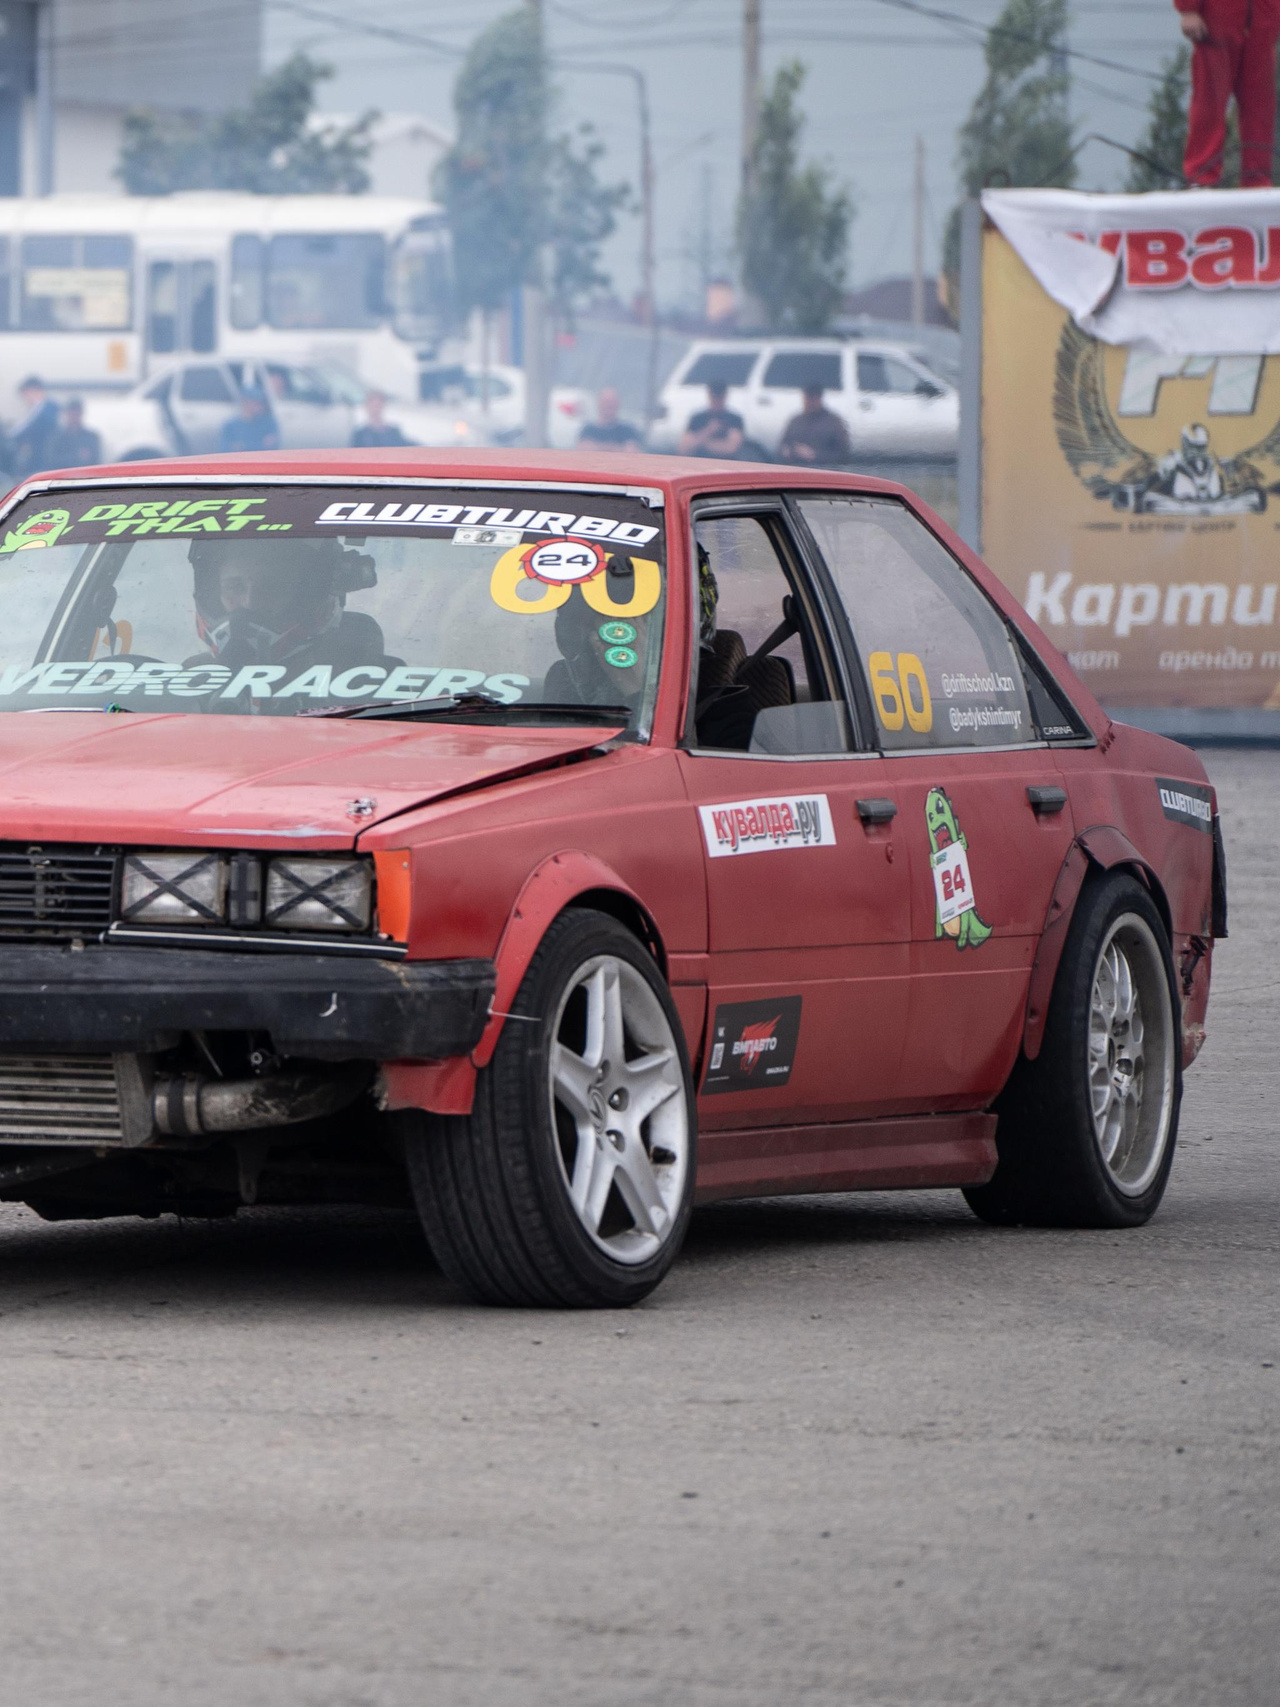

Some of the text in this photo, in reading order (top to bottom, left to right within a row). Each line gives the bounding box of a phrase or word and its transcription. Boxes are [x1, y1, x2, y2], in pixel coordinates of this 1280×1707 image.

[77, 498, 268, 523] DRIFT
[318, 502, 661, 543] CLUBTURBO
[536, 554, 592, 567] 24
[490, 542, 662, 618] 60
[1023, 571, 1280, 638] Карти
[1067, 649, 1120, 669] кат
[869, 651, 932, 733] 60
[941, 672, 1016, 698] @driftschool.kzn
[1042, 725, 1073, 736] CARINA
[711, 800, 821, 851] кувалда.ру
[941, 863, 966, 901] 24
